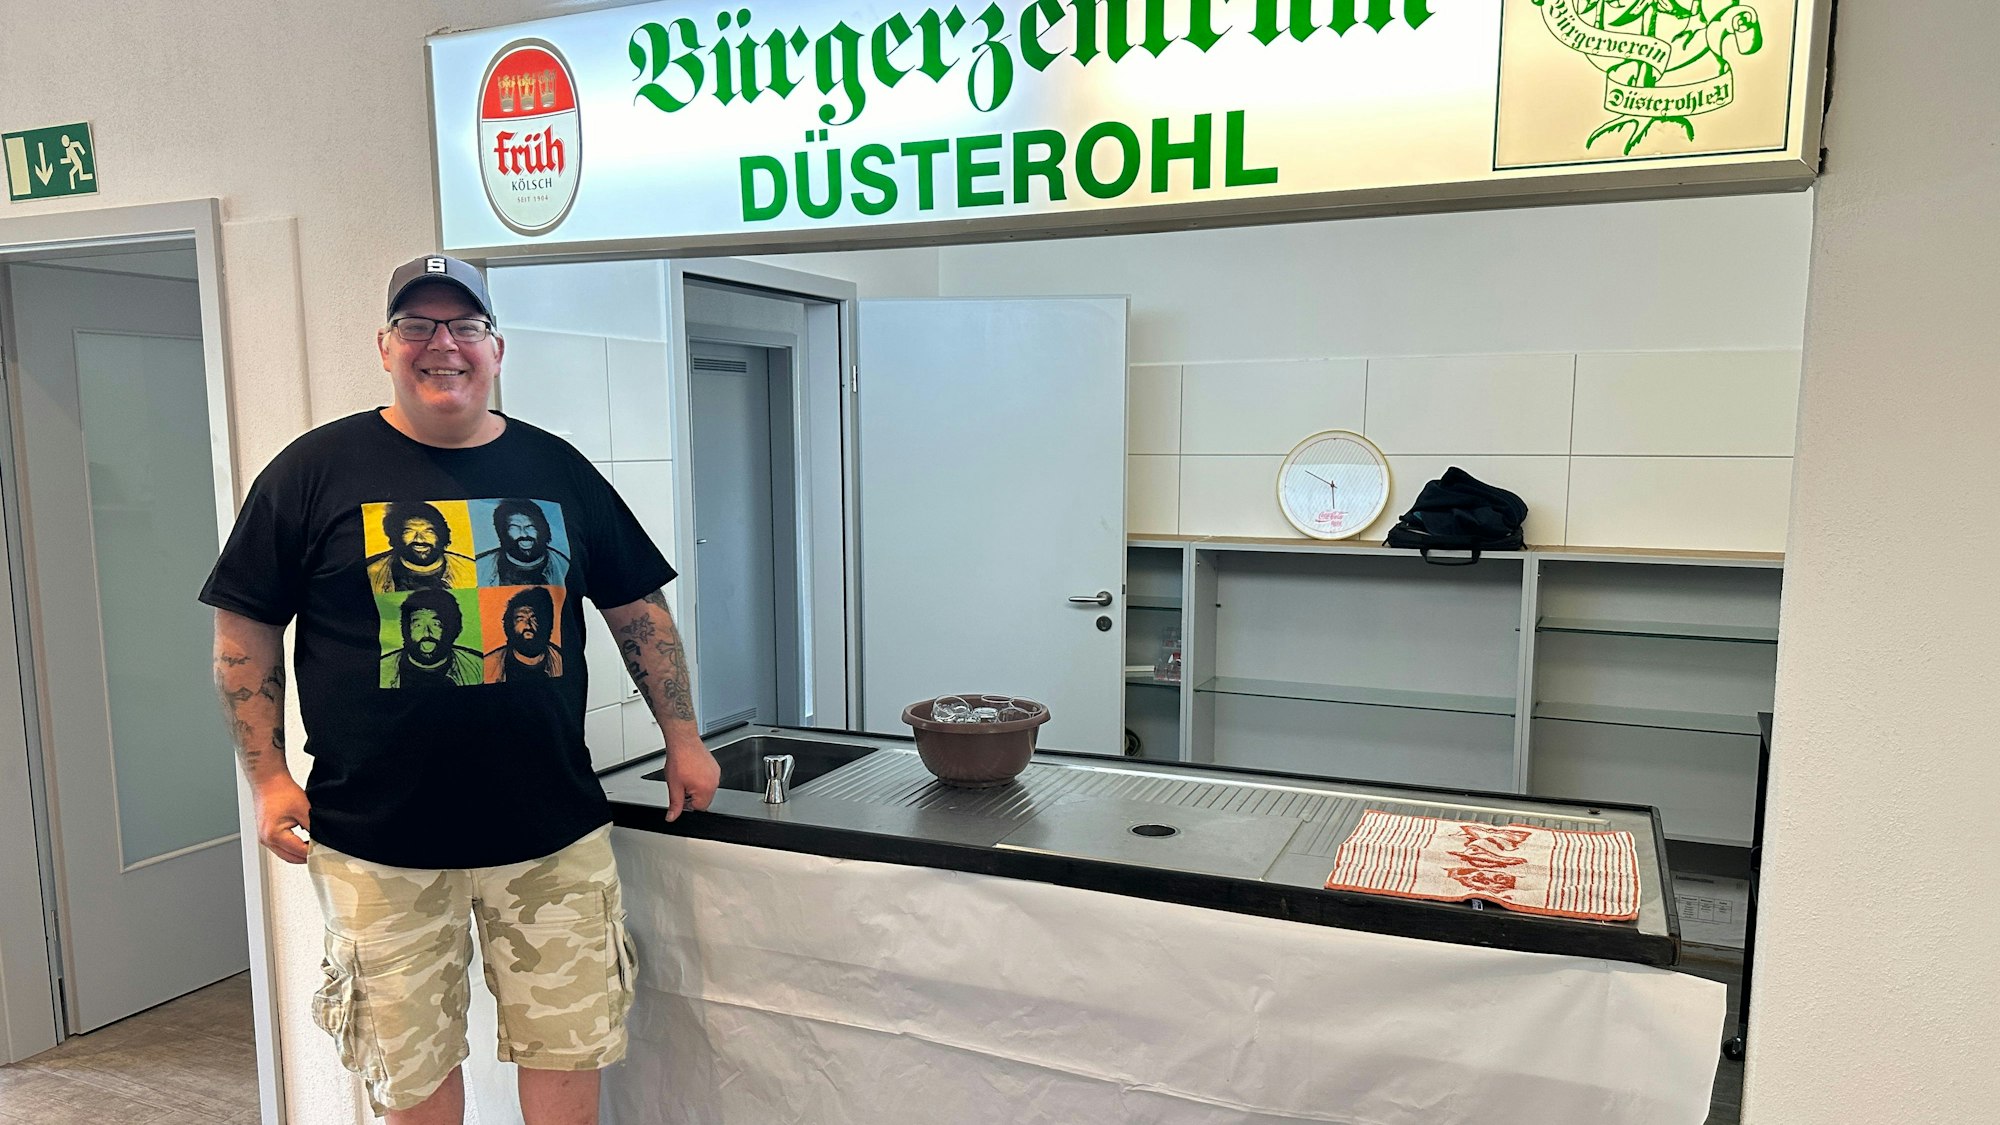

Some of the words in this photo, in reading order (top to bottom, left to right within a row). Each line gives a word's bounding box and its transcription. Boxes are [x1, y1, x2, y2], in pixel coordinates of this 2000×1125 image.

[1549, 0, 1667, 64] Bürgerverein
[494, 124, 566, 176] früh
[739, 109, 1279, 222] DÜSTEROHL
[511, 177, 553, 192] KÖLSCH
[517, 195, 532, 203] SEIT
[533, 194, 549, 202] 1904
